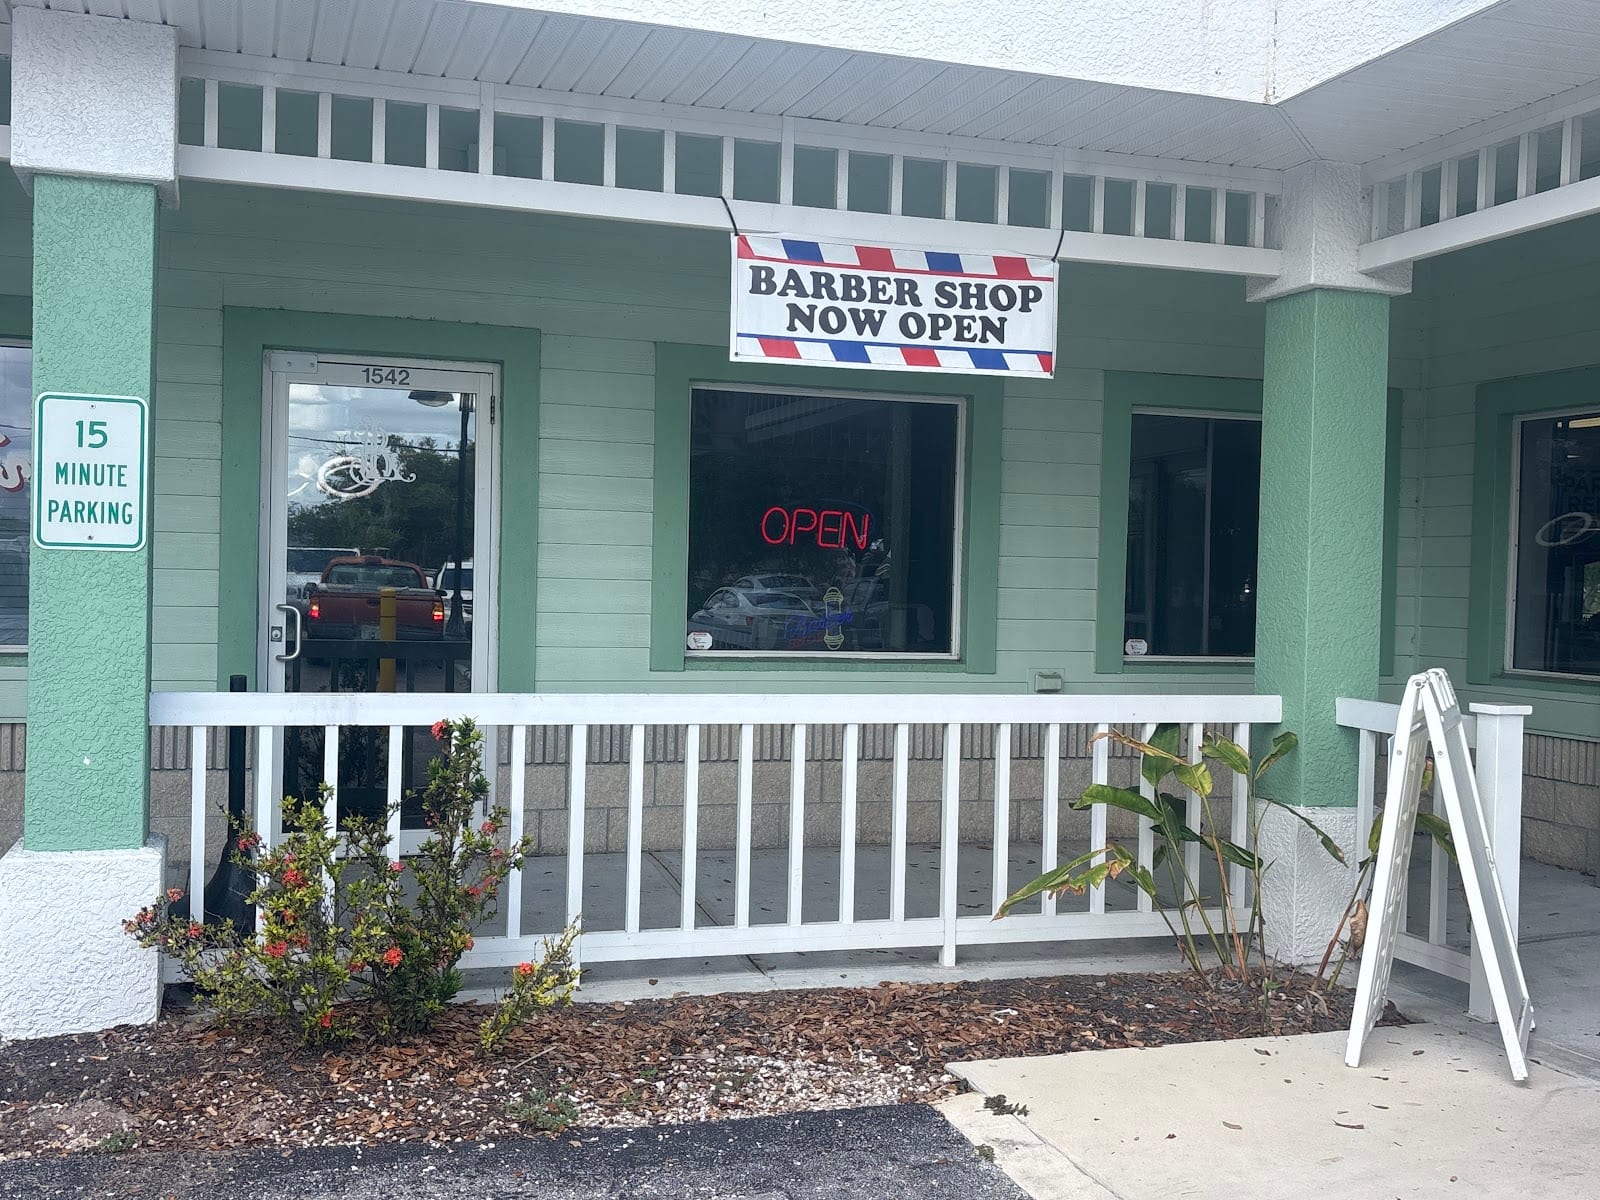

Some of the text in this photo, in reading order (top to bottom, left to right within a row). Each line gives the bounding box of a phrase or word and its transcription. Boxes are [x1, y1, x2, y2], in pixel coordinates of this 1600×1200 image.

[749, 265, 1043, 313] BARBER SHOP
[785, 302, 1008, 344] NOW OPEN
[362, 367, 411, 386] 1542
[75, 420, 108, 448] 15
[55, 461, 128, 487] MINUTE
[47, 499, 133, 525] PARKING
[761, 506, 870, 549] OPEN
